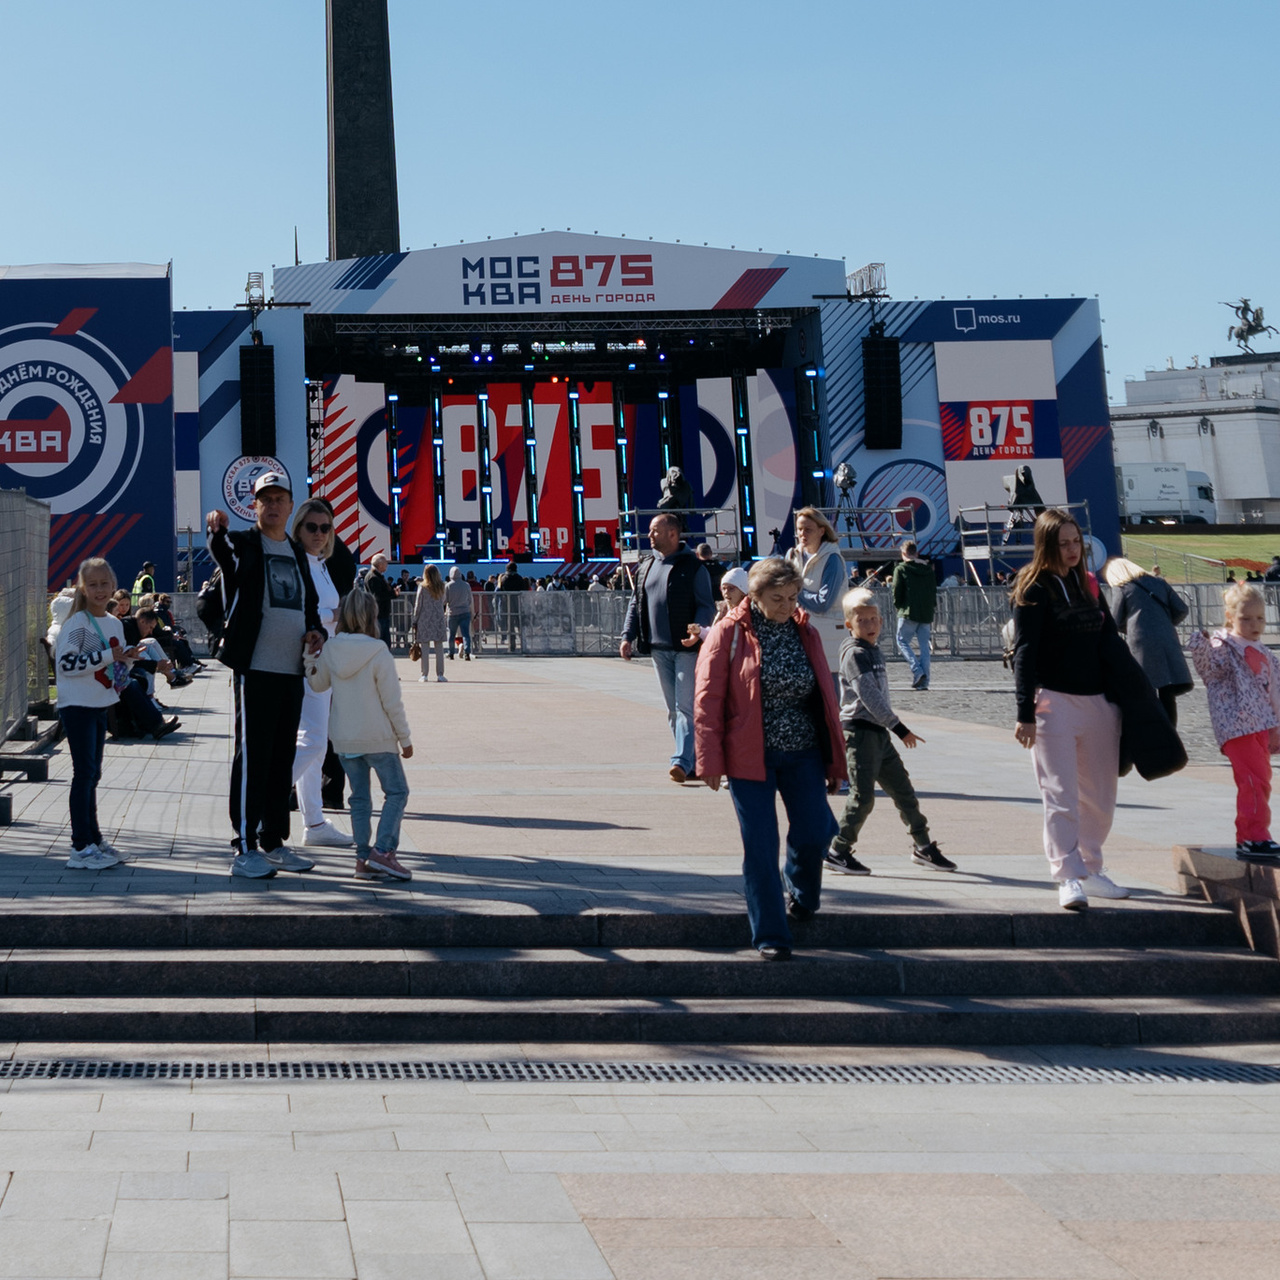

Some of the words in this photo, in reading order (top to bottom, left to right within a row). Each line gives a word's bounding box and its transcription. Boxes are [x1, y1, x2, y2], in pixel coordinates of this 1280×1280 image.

[462, 256, 540, 279] МОС
[550, 255, 654, 287] 875
[463, 282, 541, 305] КВА
[551, 294, 591, 304] ДЕНЬ
[596, 293, 655, 303] ГОРОДА
[978, 315, 1021, 323] mos.ru
[46, 366, 103, 445] РОЖДЕНИЯ
[969, 406, 1033, 445] 875
[442, 403, 619, 522] 875
[973, 446, 995, 456] ДЕНЬ
[999, 446, 1035, 455] ГОРОДА
[226, 466, 239, 498] МОСКВА
[238, 457, 251, 467] 875
[234, 506, 252, 518] ДЕНЬ
